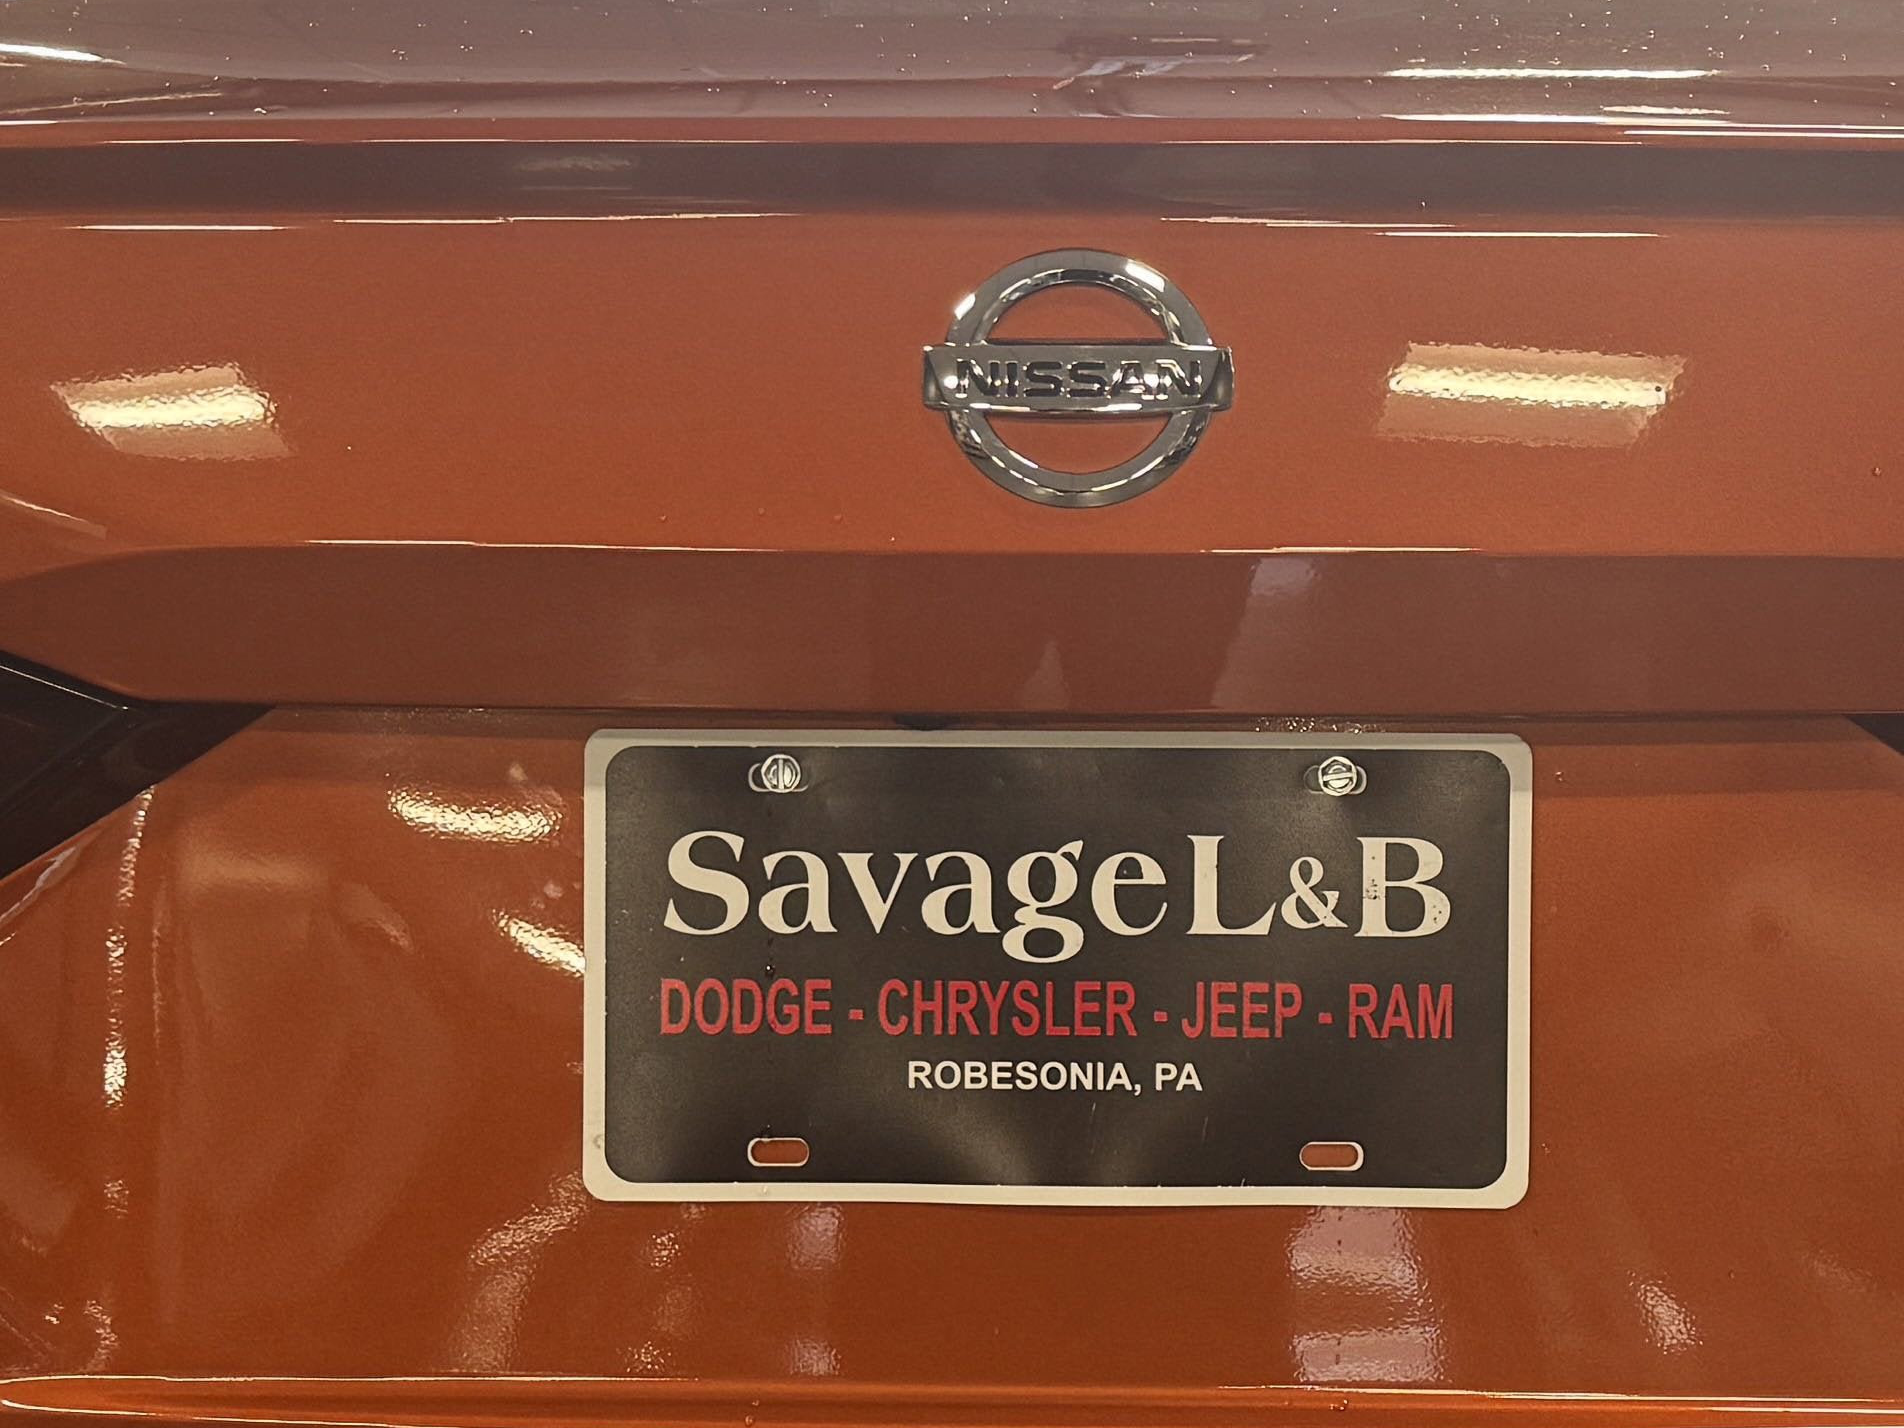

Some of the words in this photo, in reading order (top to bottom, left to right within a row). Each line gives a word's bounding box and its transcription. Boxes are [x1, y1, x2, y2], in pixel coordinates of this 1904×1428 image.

[955, 358, 1202, 400] NISSAN
[660, 977, 833, 1037] DODGE
[878, 978, 1138, 1038] CHRYSLER
[1182, 981, 1304, 1040] JEEP
[1348, 983, 1454, 1041] RAM
[908, 1060, 1142, 1096] ROBESONIA,
[1155, 1062, 1203, 1092] PA
